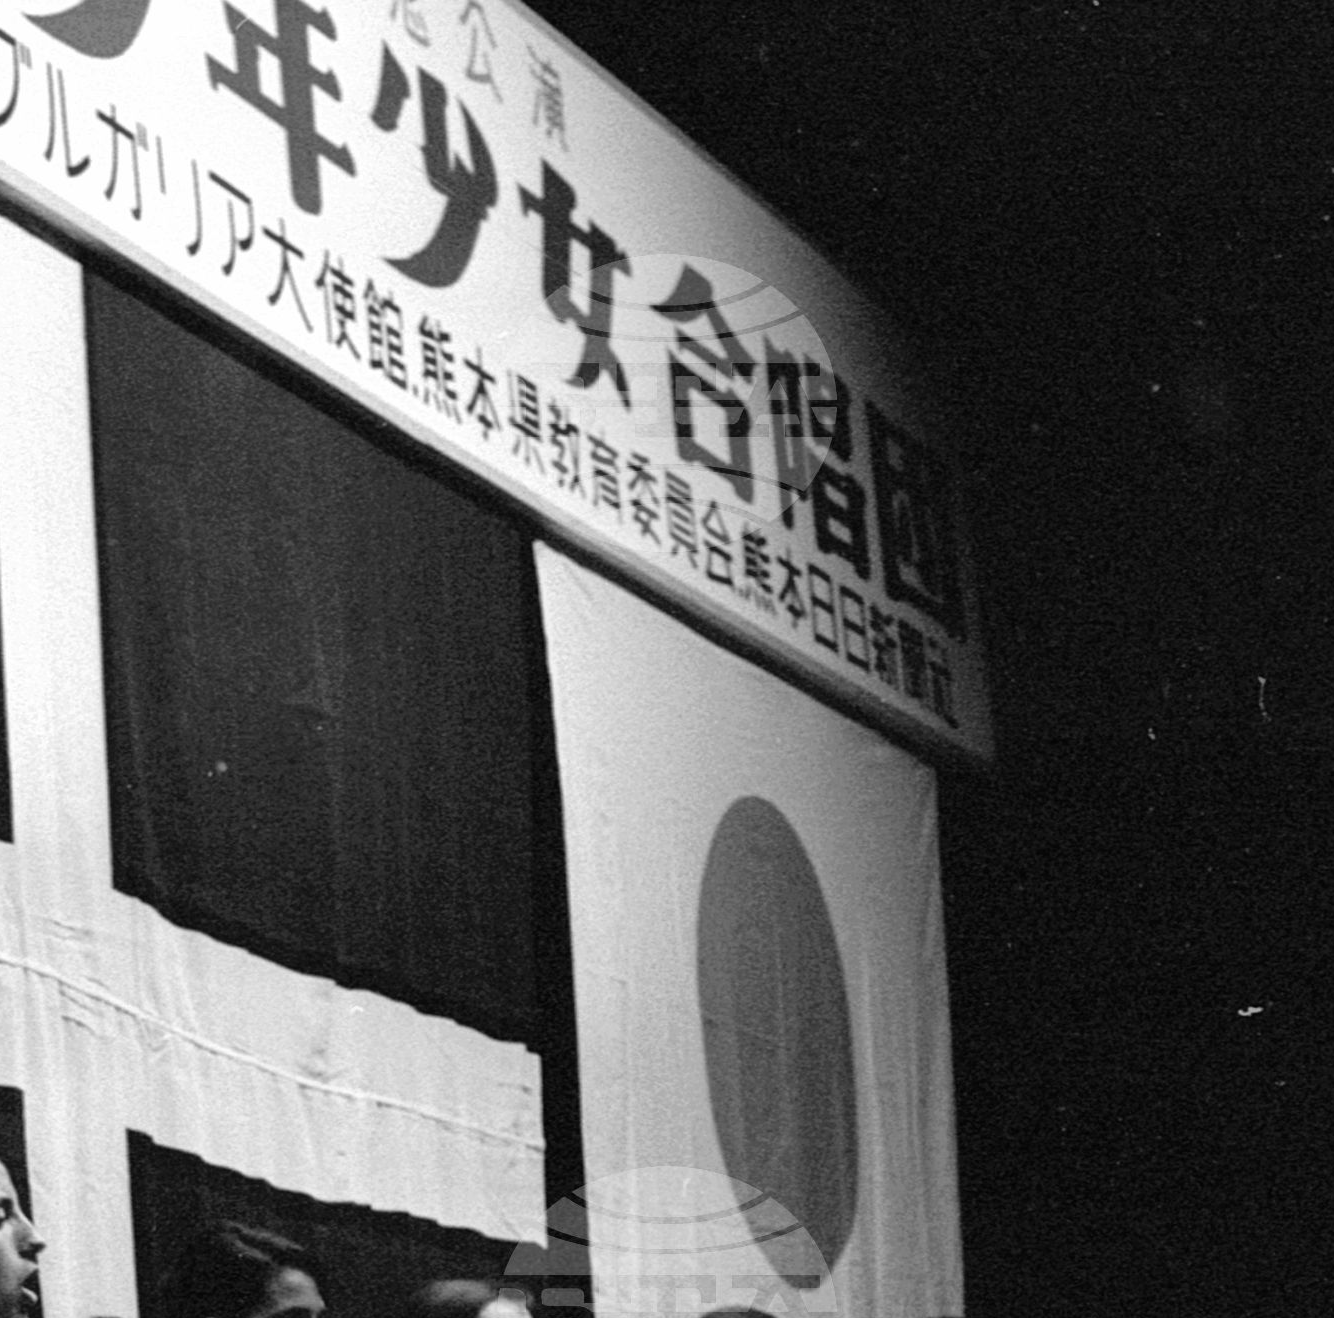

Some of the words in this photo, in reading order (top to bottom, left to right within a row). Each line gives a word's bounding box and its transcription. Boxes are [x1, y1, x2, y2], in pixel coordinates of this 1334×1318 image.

[21, 0, 968, 648] 年少女合唱団
